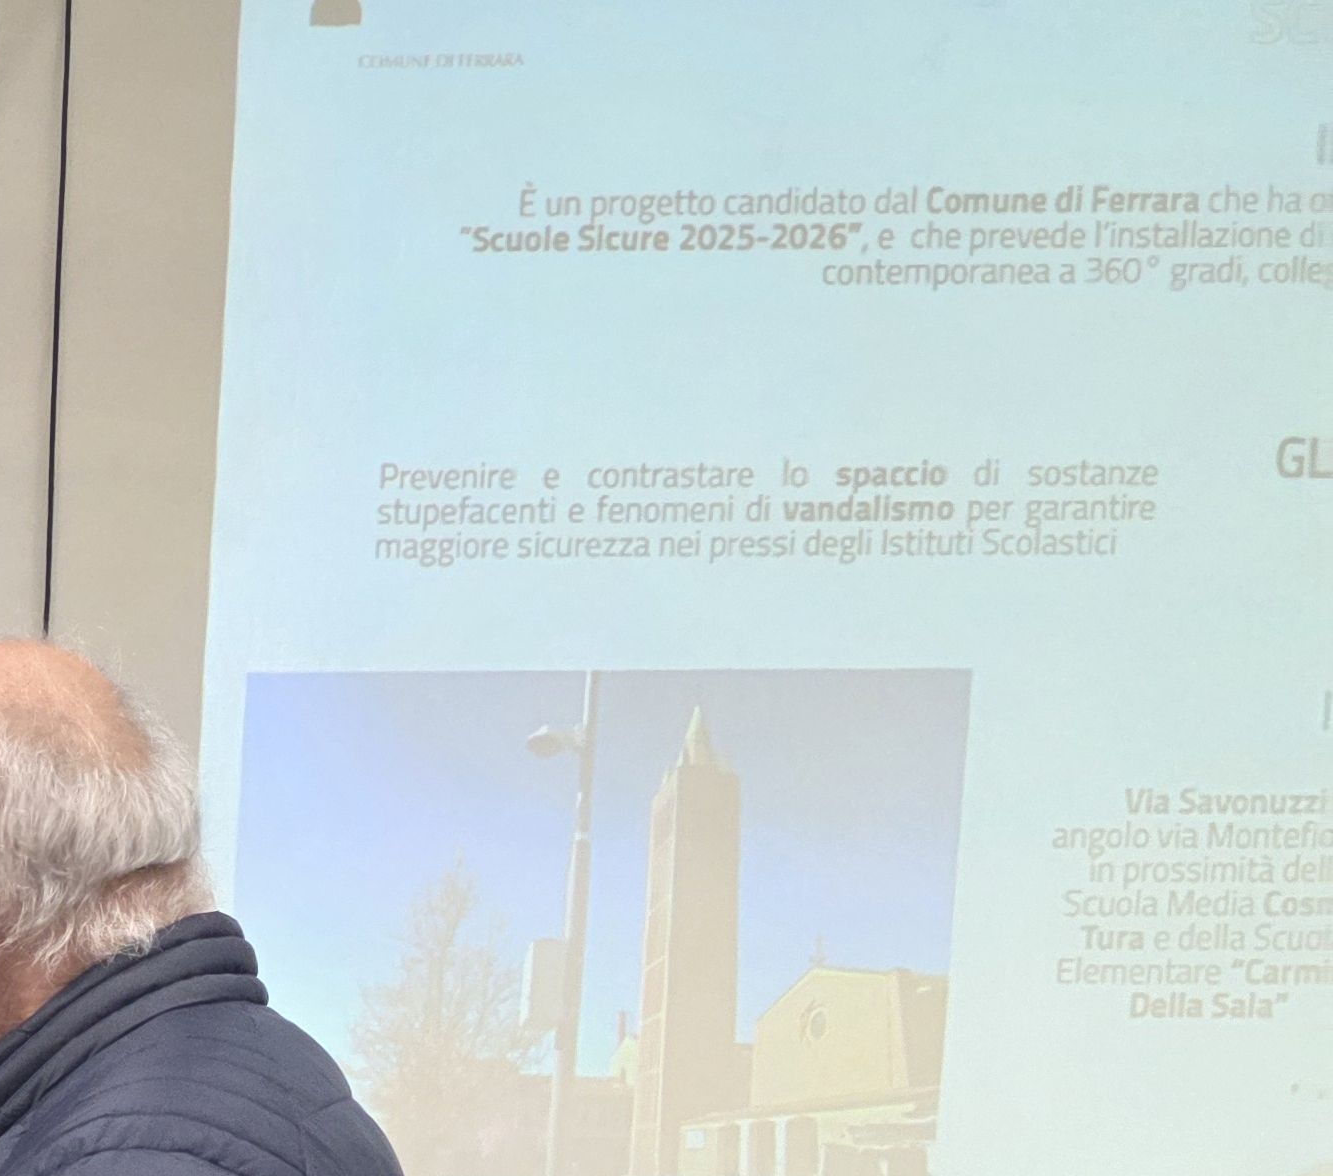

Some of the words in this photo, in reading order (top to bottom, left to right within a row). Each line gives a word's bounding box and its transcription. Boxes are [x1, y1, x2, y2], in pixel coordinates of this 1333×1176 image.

[519, 182, 537, 217] È
[545, 194, 580, 216] un
[590, 190, 715, 224] progetto
[723, 186, 865, 216] candidato
[874, 186, 917, 213] dal
[926, 186, 1047, 214] Comune
[1054, 185, 1083, 213] di
[1091, 185, 1199, 213] Ferrara
[1207, 185, 1258, 213] che
[1267, 184, 1301, 213] ha
[577, 224, 669, 251] Sicure
[877, 227, 894, 248] e
[909, 221, 960, 248] che
[968, 220, 1086, 255] prevede
[1299, 219, 1324, 247] di
[822, 259, 1049, 291] contemporanea
[1058, 264, 1076, 284] a
[1085, 256, 1160, 284] 360°
[1170, 255, 1249, 291] gradi,
[378, 462, 517, 490] Prevenire
[542, 468, 559, 489] e
[586, 461, 754, 488] contrastare
[781, 460, 810, 487] lo
[835, 459, 950, 493] spaccio
[973, 459, 999, 486] di
[1027, 460, 1158, 486] sostanze
[376, 496, 555, 531] stupefacenti
[567, 503, 584, 524] e
[596, 495, 734, 524] fenomeni
[745, 494, 769, 522] di
[783, 493, 954, 522] vandalismo
[965, 499, 1012, 528] per
[1025, 493, 1156, 528] garantire
[374, 532, 509, 568] maggiore
[516, 531, 650, 559] sicurezza
[657, 530, 701, 558] nei
[709, 529, 795, 563] pressi
[803, 529, 872, 564] degli
[882, 528, 972, 556] Istituti
[982, 528, 1116, 556] Scolastici
[1124, 787, 1169, 814] Via
[1178, 787, 1327, 814] Savonuzzi
[1051, 821, 1150, 856] angolo
[1157, 821, 1199, 848] via
[1088, 859, 1114, 883] in
[1122, 855, 1274, 889] prossimità
[1062, 889, 1157, 917] Scuola
[1166, 889, 1255, 917] Media
[1081, 925, 1143, 950] Tura
[1153, 929, 1170, 950] e
[1177, 923, 1245, 950] della
[1055, 957, 1222, 985] Elementare
[1129, 992, 1204, 1019] Della
